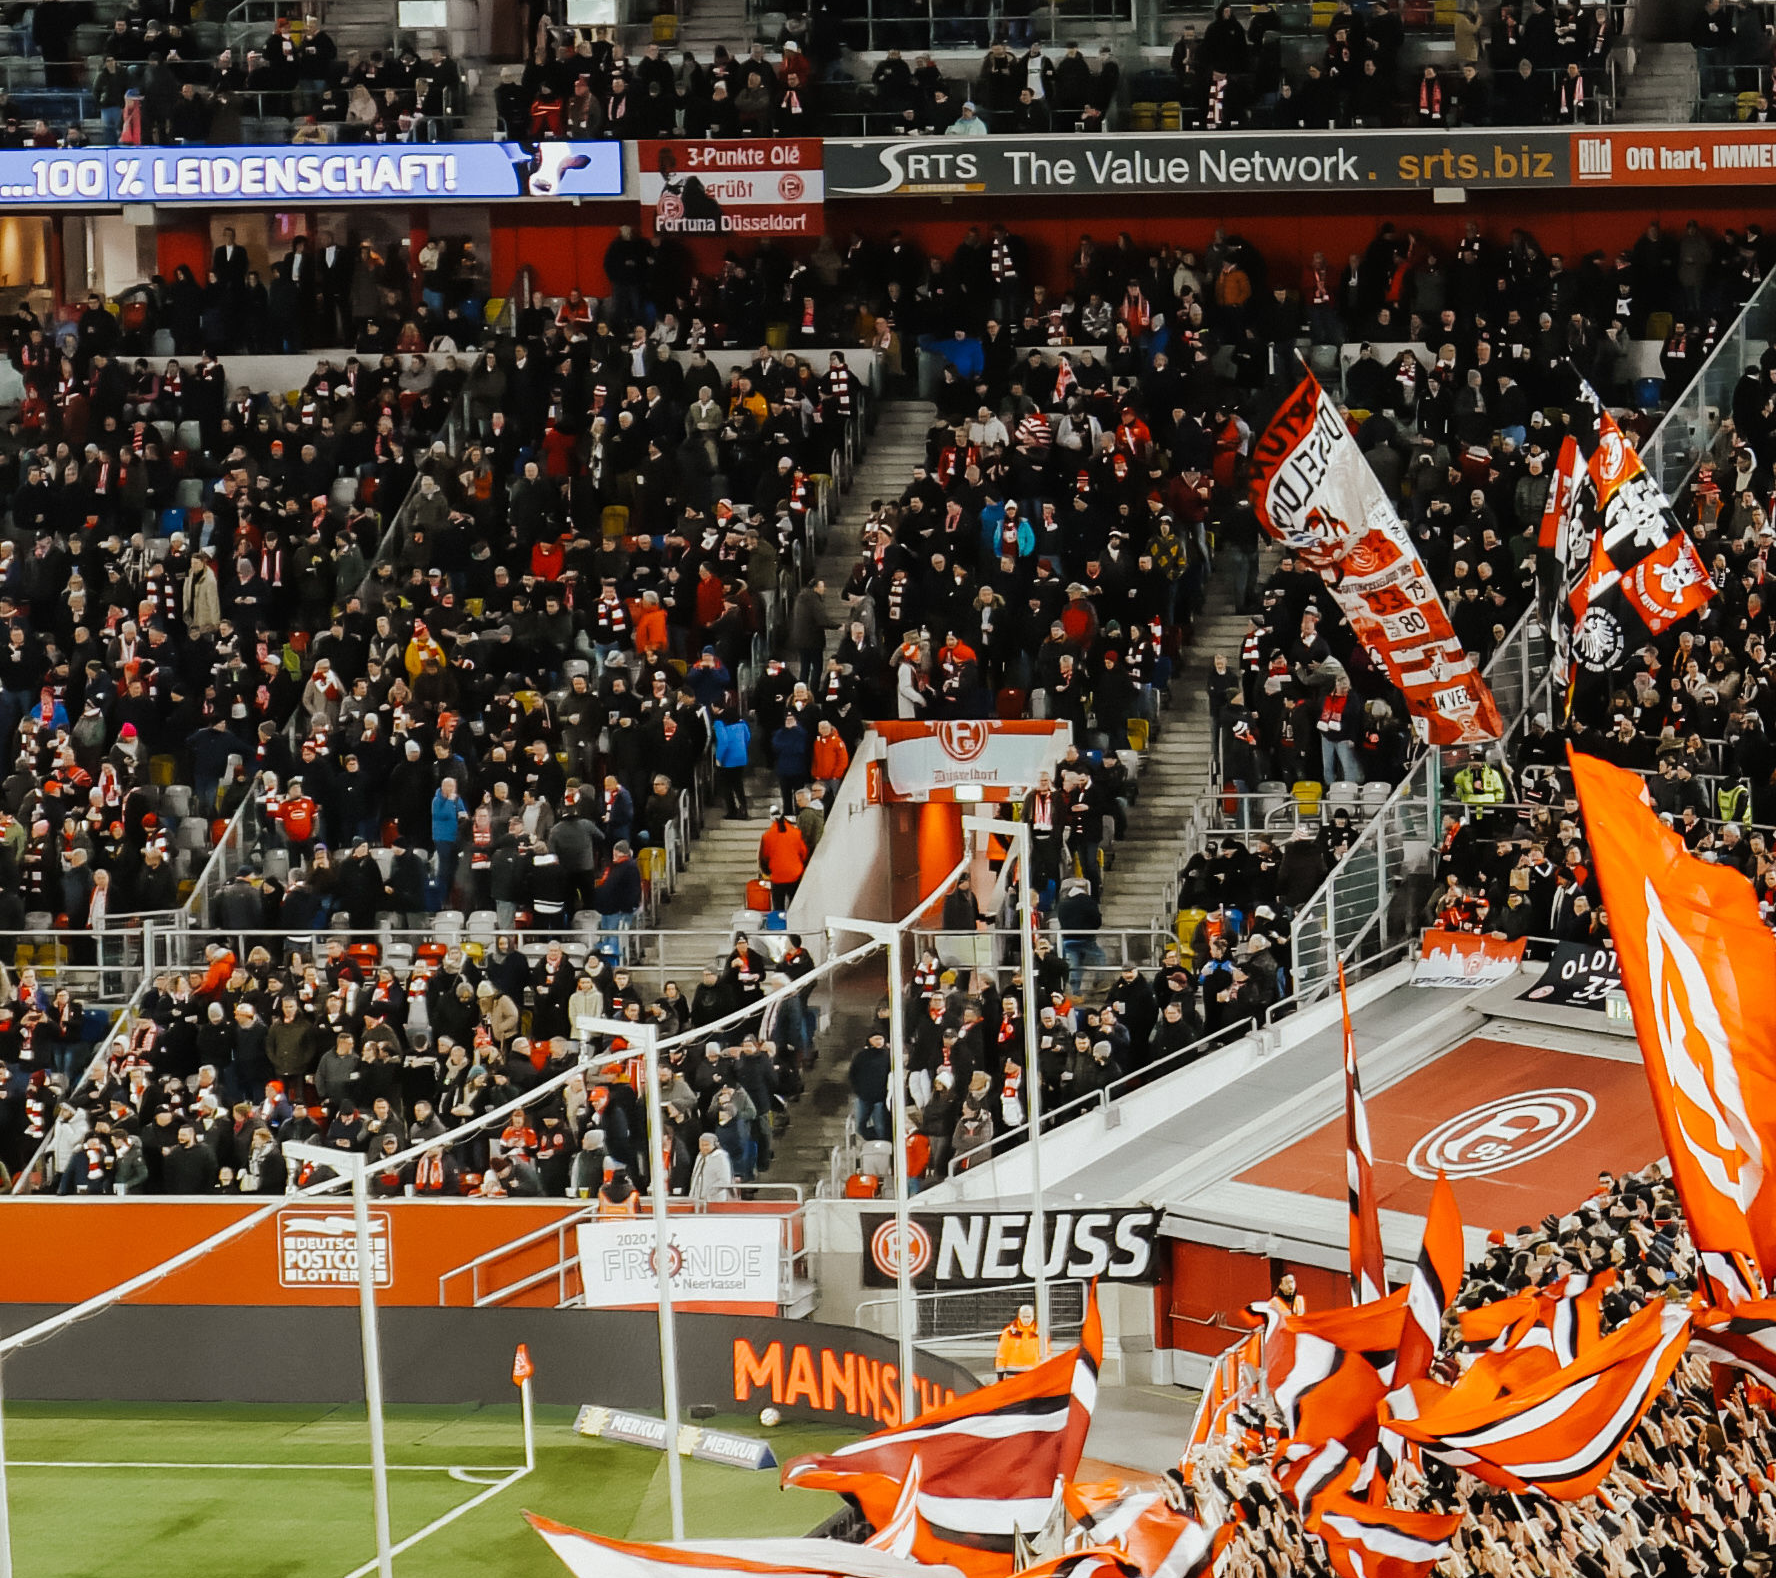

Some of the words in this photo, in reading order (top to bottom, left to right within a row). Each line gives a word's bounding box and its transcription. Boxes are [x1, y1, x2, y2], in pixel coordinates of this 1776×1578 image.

[687, 146, 765, 167] 3-Punkte
[1003, 150, 1076, 185] The
[1085, 149, 1190, 185] Value
[1199, 147, 1360, 183] Network
[1399, 144, 1554, 180] srts.biz
[1626, 147, 1655, 172] Oft
[1660, 146, 1707, 172] hart,
[154, 154, 459, 196] LEIDENSCHAFT!
[656, 214, 716, 232] Fortuna
[721, 213, 807, 232] Düsseldorf
[1562, 949, 1622, 980] OLDT
[1573, 975, 1622, 1001] 33
[296, 1237, 375, 1250] DEUTSCE
[616, 1233, 648, 1247] 2020
[935, 1212, 1154, 1279] NEUSS
[284, 1250, 386, 1270] POSTCOE
[297, 1269, 375, 1282] LOTTERE
[682, 1277, 746, 1290] Neerkassel
[610, 1414, 667, 1440] MERKUR
[702, 1434, 761, 1461] MERKUR
